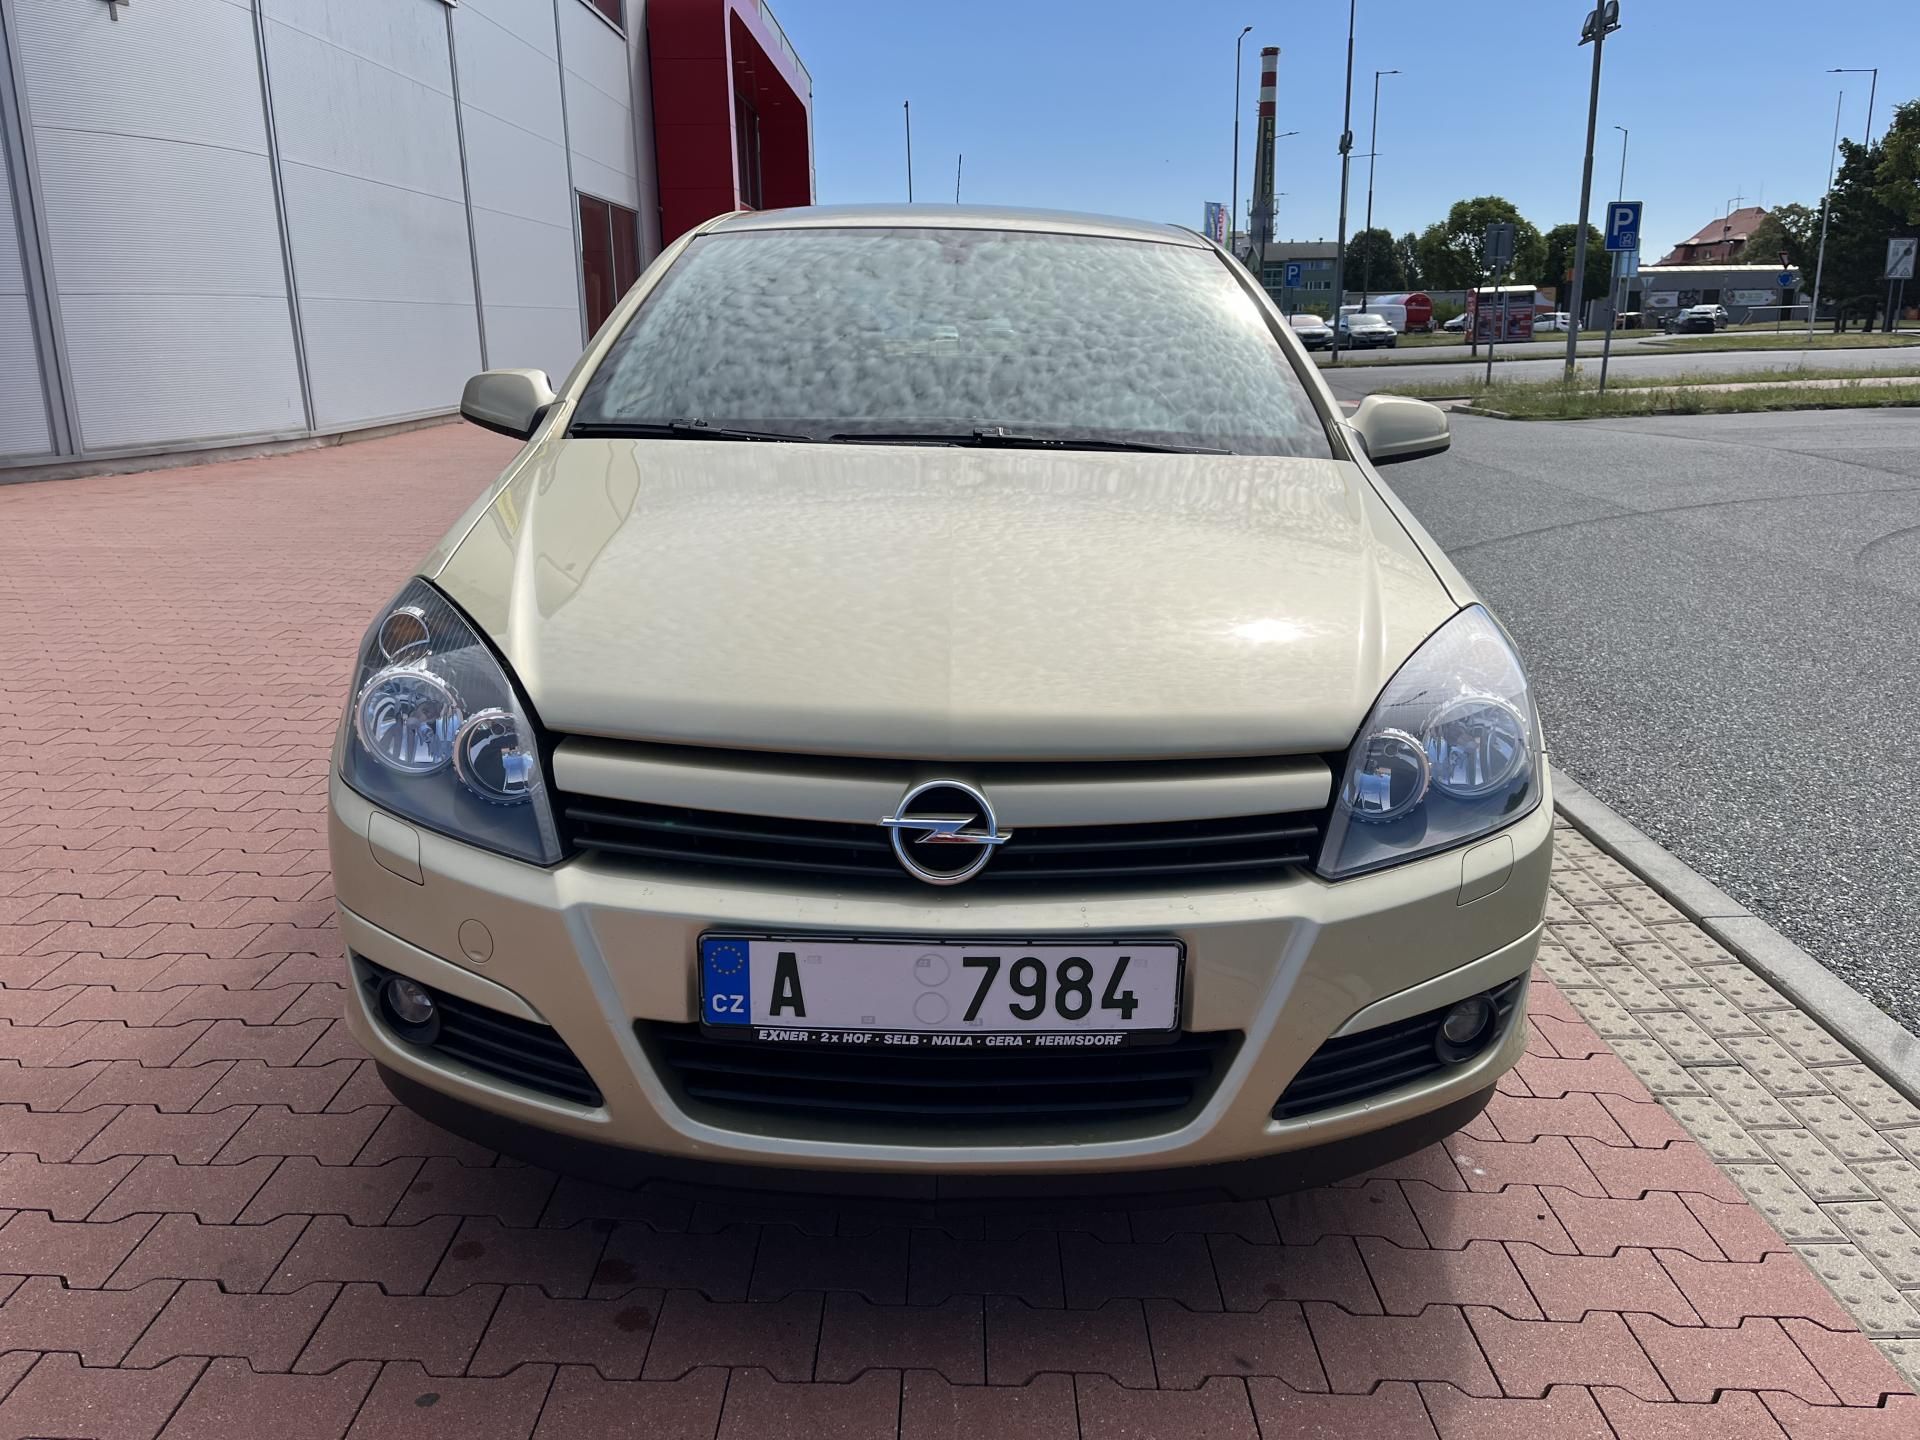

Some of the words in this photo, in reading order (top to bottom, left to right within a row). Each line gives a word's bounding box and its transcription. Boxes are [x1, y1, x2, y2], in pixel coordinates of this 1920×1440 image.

[1613, 208, 1633, 236] P
[1288, 266, 1298, 280] P
[769, 952, 806, 1017] A
[963, 957, 1138, 1021] 7984
[712, 994, 744, 1013] CZ
[759, 1030, 808, 1041] EXNER
[820, 1033, 839, 1043] 2x
[842, 1033, 873, 1043] HOF
[884, 1034, 919, 1045] SELB
[932, 1035, 973, 1046] NAILA
[985, 1035, 1022, 1046] GERA
[1035, 1035, 1122, 1046] HERMSDORF
